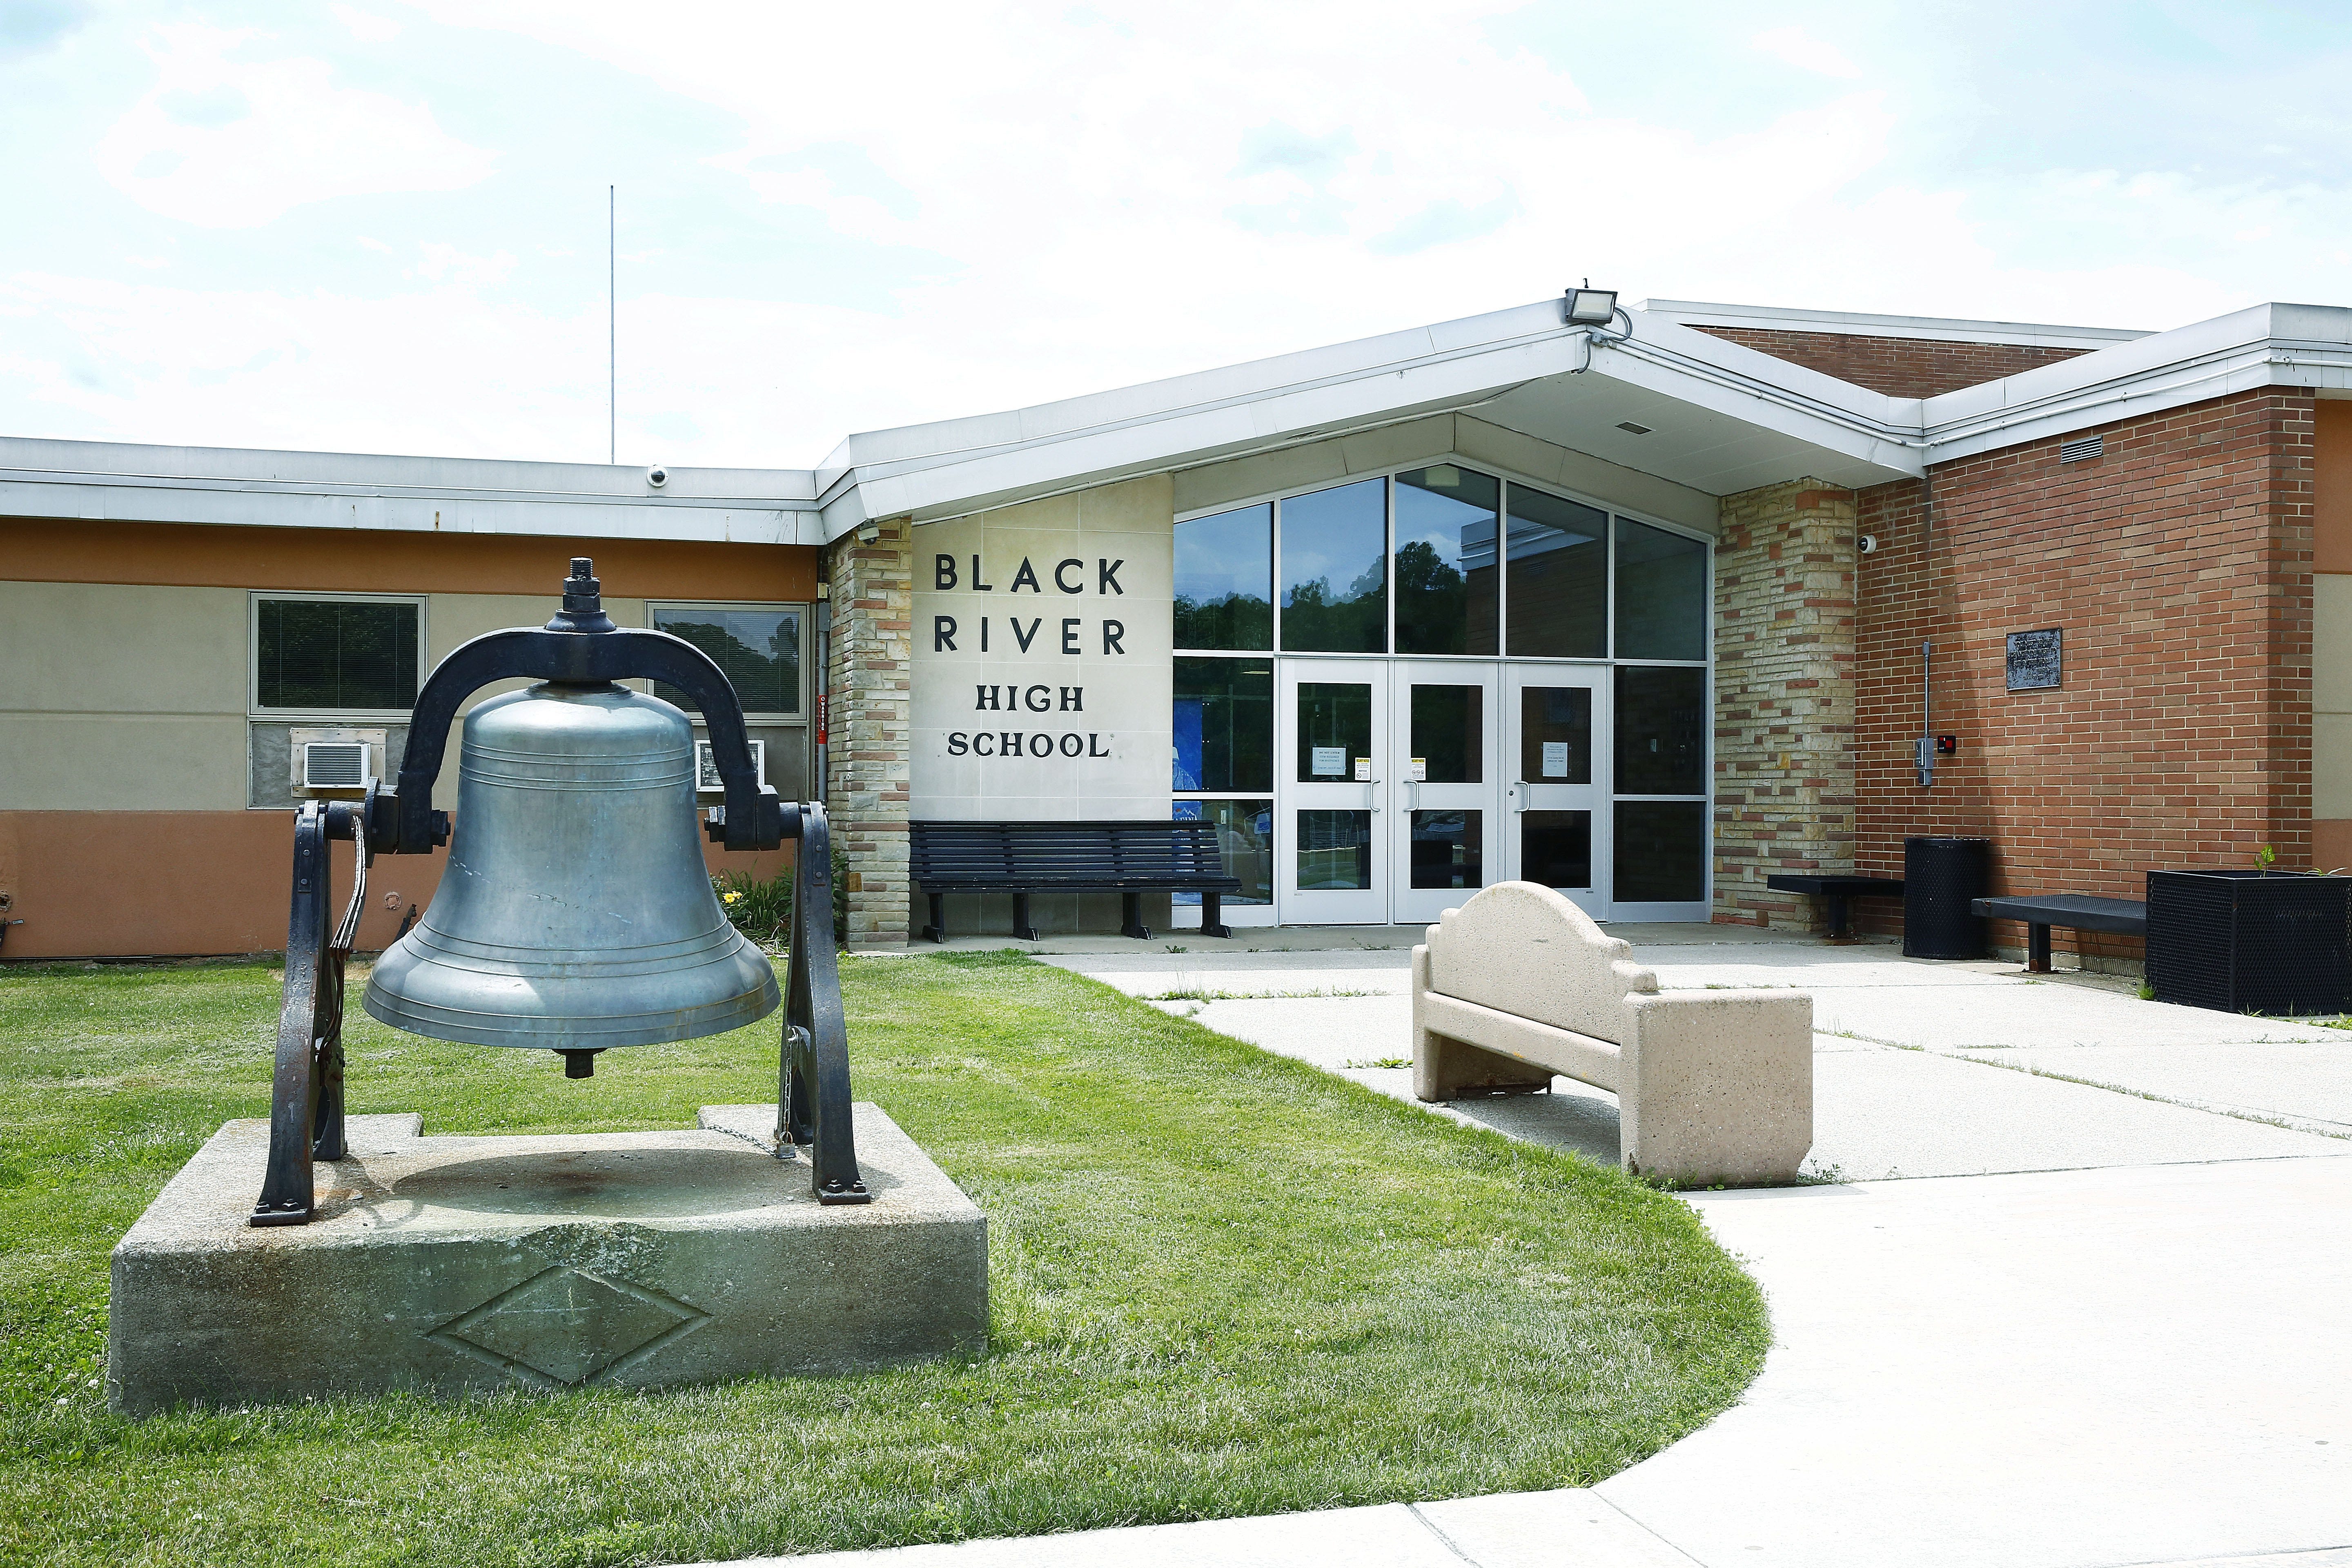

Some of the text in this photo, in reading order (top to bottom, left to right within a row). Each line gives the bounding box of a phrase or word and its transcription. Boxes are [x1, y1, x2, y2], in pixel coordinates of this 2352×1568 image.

[935, 554, 1125, 595] BLACK
[934, 615, 1125, 655] RIVER
[975, 684, 1084, 712] HIGH
[947, 732, 1109, 758] SCHOOL
